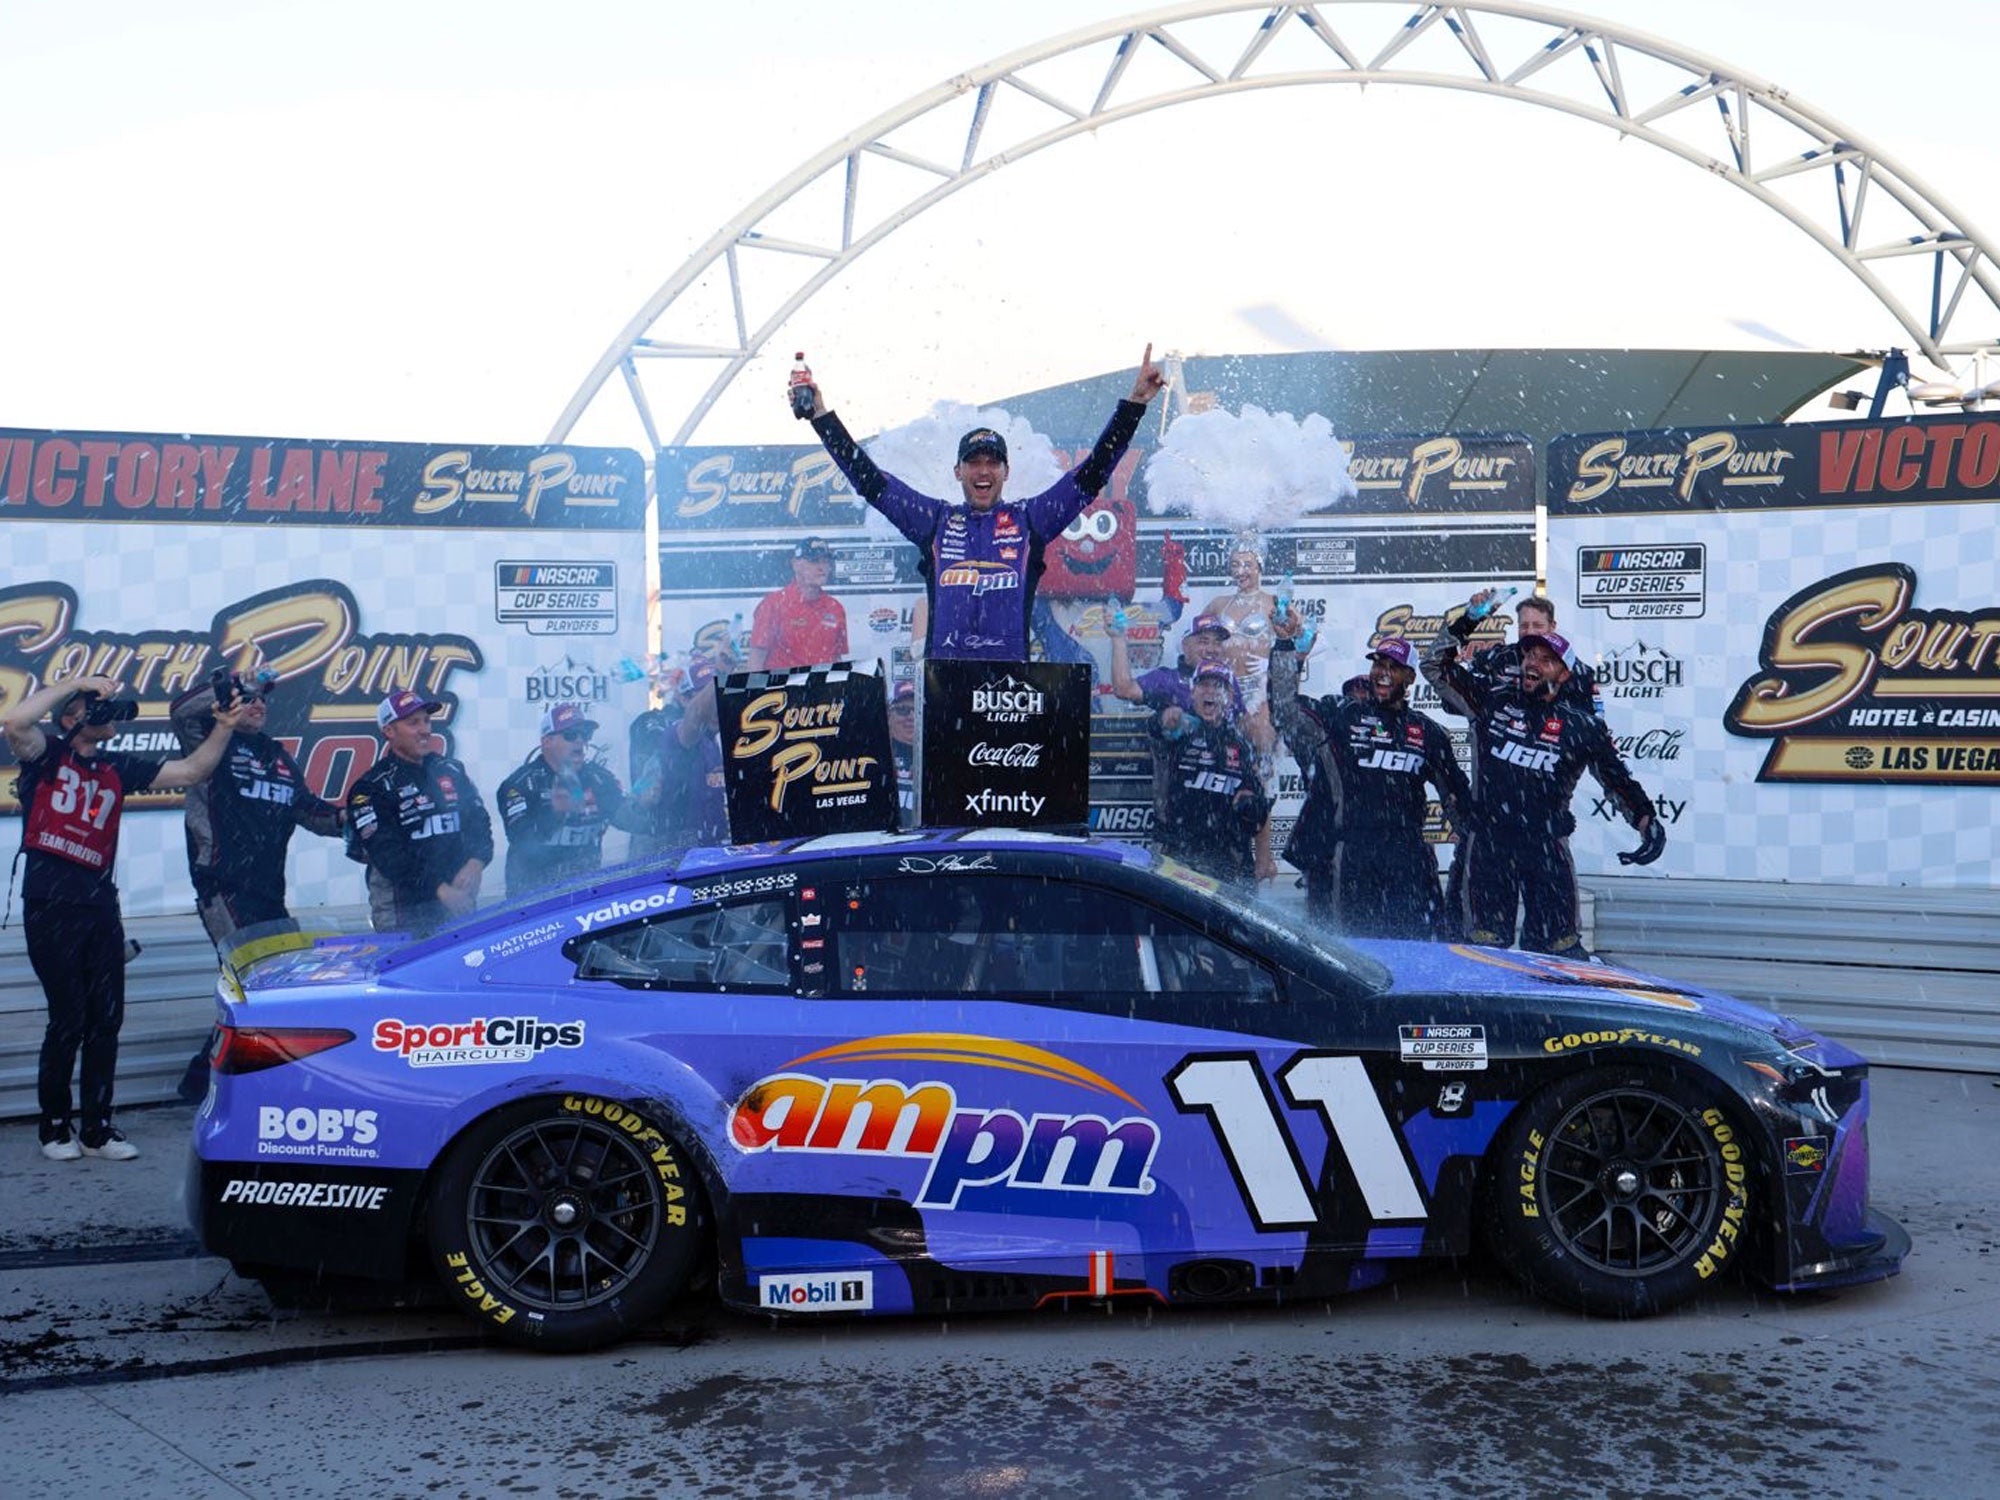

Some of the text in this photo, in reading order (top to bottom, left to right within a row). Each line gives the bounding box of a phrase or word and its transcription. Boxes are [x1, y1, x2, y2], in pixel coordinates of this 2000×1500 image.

[1339, 437, 1516, 505] OUTH POINT
[1567, 430, 1794, 503] SOUTH POINT
[1819, 422, 2000, 494] VICTO
[247, 447, 388, 513] LANE
[413, 451, 627, 520] SOUTH POINT
[1619, 551, 1685, 569] NASCAR
[535, 567, 599, 584] NASCAR
[1596, 576, 1685, 593] CUP SERIES
[514, 593, 599, 609] CUP SERIES
[1628, 604, 1684, 616] PLAYOFFS
[546, 620, 599, 631] PLAYOFFS
[1738, 576, 2000, 730] SOUT
[1596, 660, 1684, 687] BUSCH
[526, 675, 607, 702] BUSCH
[972, 690, 1044, 714] BUSCH
[1614, 687, 1664, 699] LIGHT
[733, 690, 845, 759] SOUTH
[986, 713, 1028, 723] LIGHT
[1849, 708, 1918, 727] HOTEL
[1922, 711, 1935, 724] &
[1358, 749, 1425, 775] JGR
[1490, 740, 1562, 773] JGR
[1881, 747, 1929, 770] LAS
[770, 741, 878, 814] POINT
[816, 794, 867, 808] LAS VEGAS
[965, 788, 1046, 817] xfinity
[576, 885, 678, 932] yahoo!
[490, 922, 564, 953] NATIONAL
[501, 932, 558, 957] DEBT RELIEF
[1427, 1027, 1472, 1038] NASCAR
[1544, 1028, 1702, 1057] GOODYEAR
[416, 1049, 527, 1063] HAIRCUTS
[1413, 1042, 1475, 1053] CUP SERIES
[1435, 1060, 1475, 1069] PLAYOFFS
[259, 1106, 378, 1145] BOB'S
[258, 1142, 316, 1156] Discount
[1172, 1054, 1430, 1225] 11
[563, 1095, 687, 1228] GOODYEAR
[1520, 1129, 1545, 1219] EAGLE
[220, 1180, 389, 1210] PROGRESSIVE
[1693, 1107, 1748, 1280] GOODYEAR
[447, 1252, 517, 1325] EAGLE
[768, 1281, 836, 1305] Mobil
